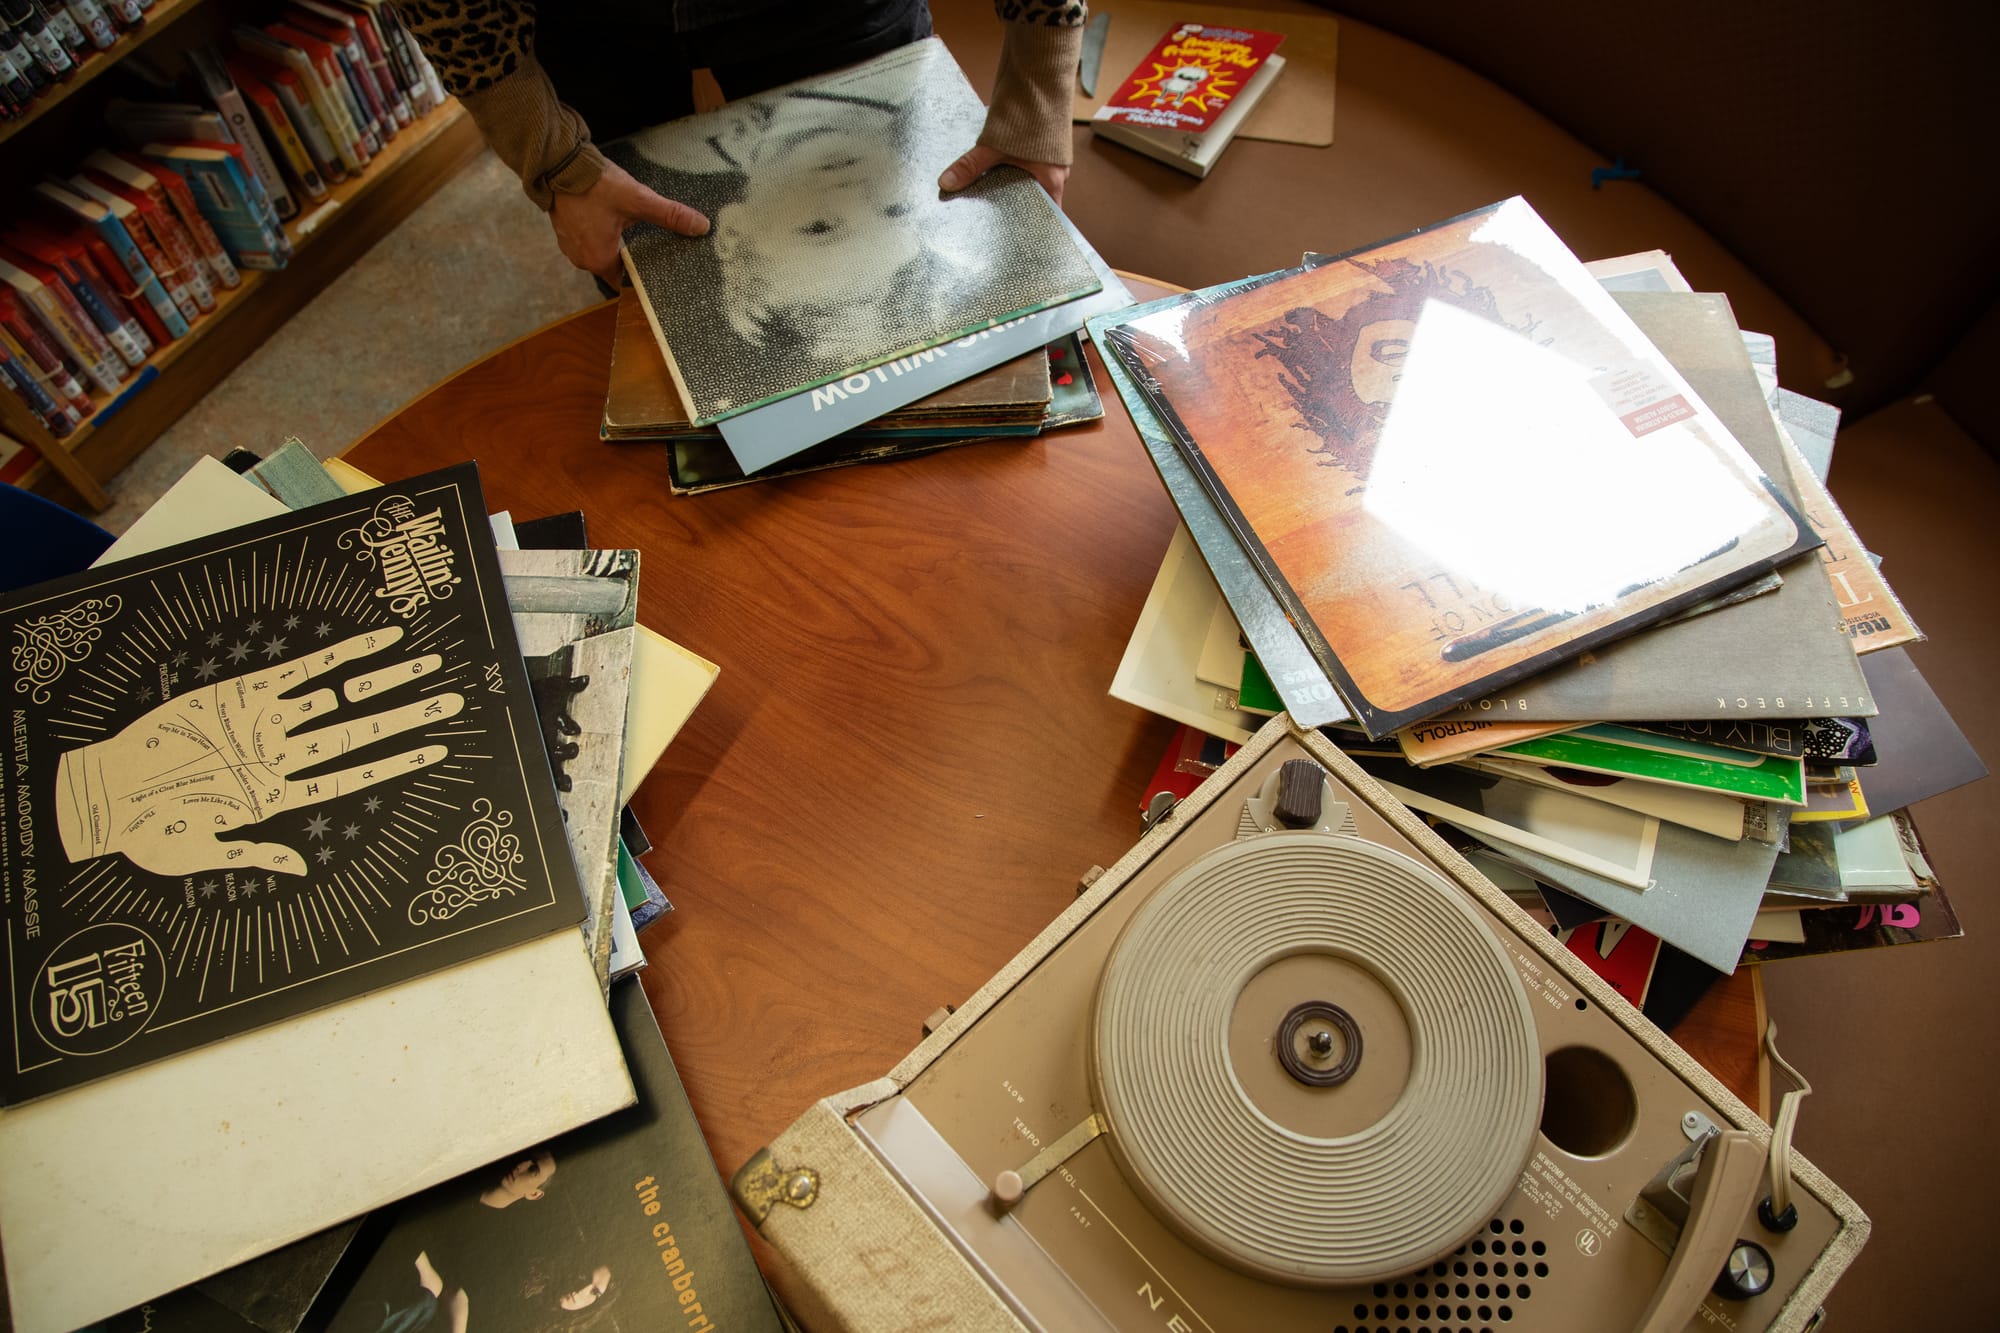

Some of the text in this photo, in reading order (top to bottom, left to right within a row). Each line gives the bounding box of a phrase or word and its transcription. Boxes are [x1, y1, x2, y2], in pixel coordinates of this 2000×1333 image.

[360, 530, 431, 619] Jennys
[159, 663, 171, 701] PERCUSSION
[169, 671, 179, 685] THE
[1457, 698, 1528, 711] BLOW
[1716, 696, 1865, 709] JEFF BECK
[158, 723, 170, 734] Keep
[197, 737, 211, 751] Heart
[1725, 720, 1792, 752] BILLY
[130, 791, 148, 804] Light
[159, 784, 175, 793] Clear
[189, 774, 216, 785] Morning
[12, 709, 41, 941] MEHTA MOODY MASSE
[128, 810, 156, 833] The Valley
[183, 877, 196, 910] PASSION
[224, 872, 237, 903] REASON
[265, 874, 277, 894] WILL
[103, 939, 149, 1017] Fifteen
[1519, 954, 1570, 1001] REMOVE BOTTOM
[48, 952, 108, 1037] 15
[1542, 990, 1562, 1010] TUBES
[1002, 1079, 1025, 1105] SLOW
[1012, 1116, 1078, 1189] TEMPO CTROL
[1523, 1171, 1540, 1188] MODEL
[1529, 1184, 1546, 1201] VOLTS
[1530, 1159, 1542, 1171] LOS
[1575, 1201, 1592, 1218] MADE
[1536, 1151, 1565, 1179] NEWCOMB
[1563, 1176, 1581, 1195] AUDIO
[1581, 1192, 1610, 1221] PRODUCTS
[634, 1175, 661, 1217] the
[1523, 1187, 1540, 1204] WATTS
[1070, 1205, 1092, 1230] FAST
